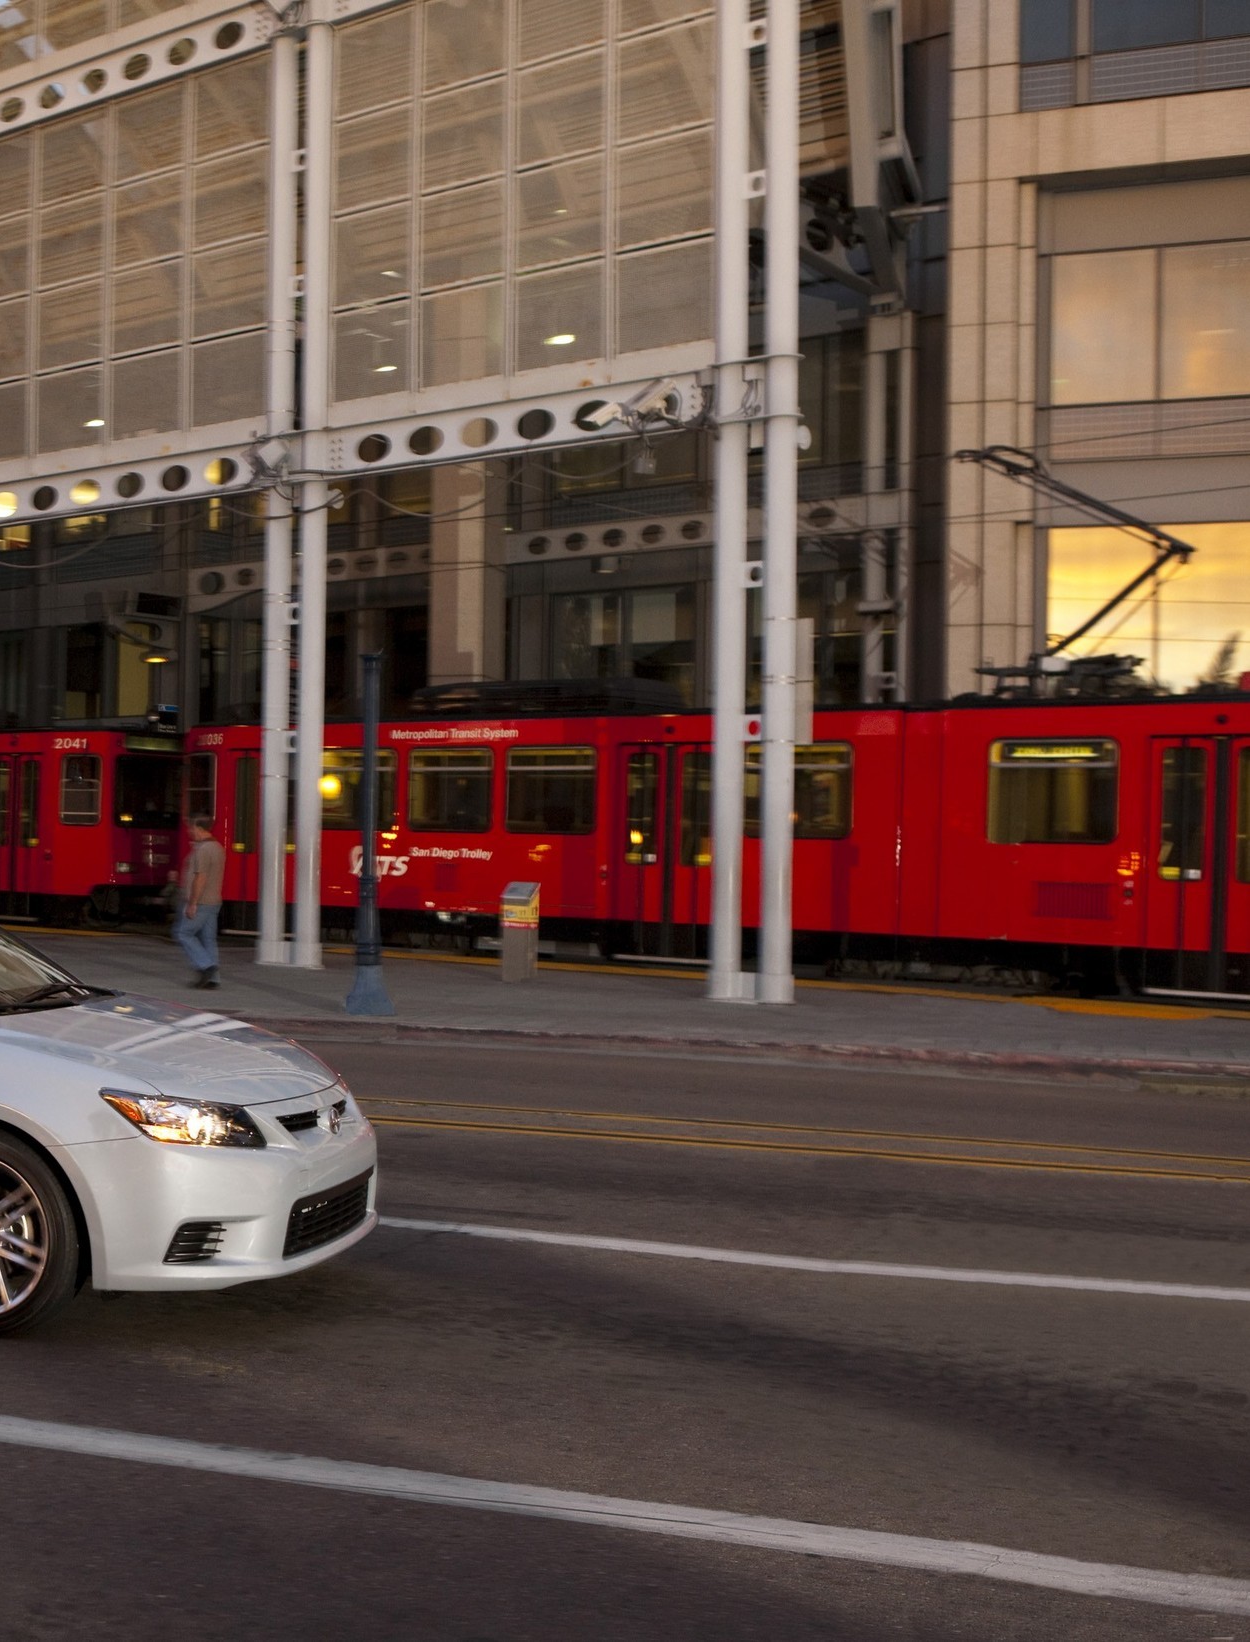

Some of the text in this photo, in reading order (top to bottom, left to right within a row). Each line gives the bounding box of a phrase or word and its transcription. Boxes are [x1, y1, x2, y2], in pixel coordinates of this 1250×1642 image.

[390, 728, 519, 740] Metropolitan Transit System
[54, 738, 88, 749] 2041
[411, 847, 493, 861] San Diego Trolley
